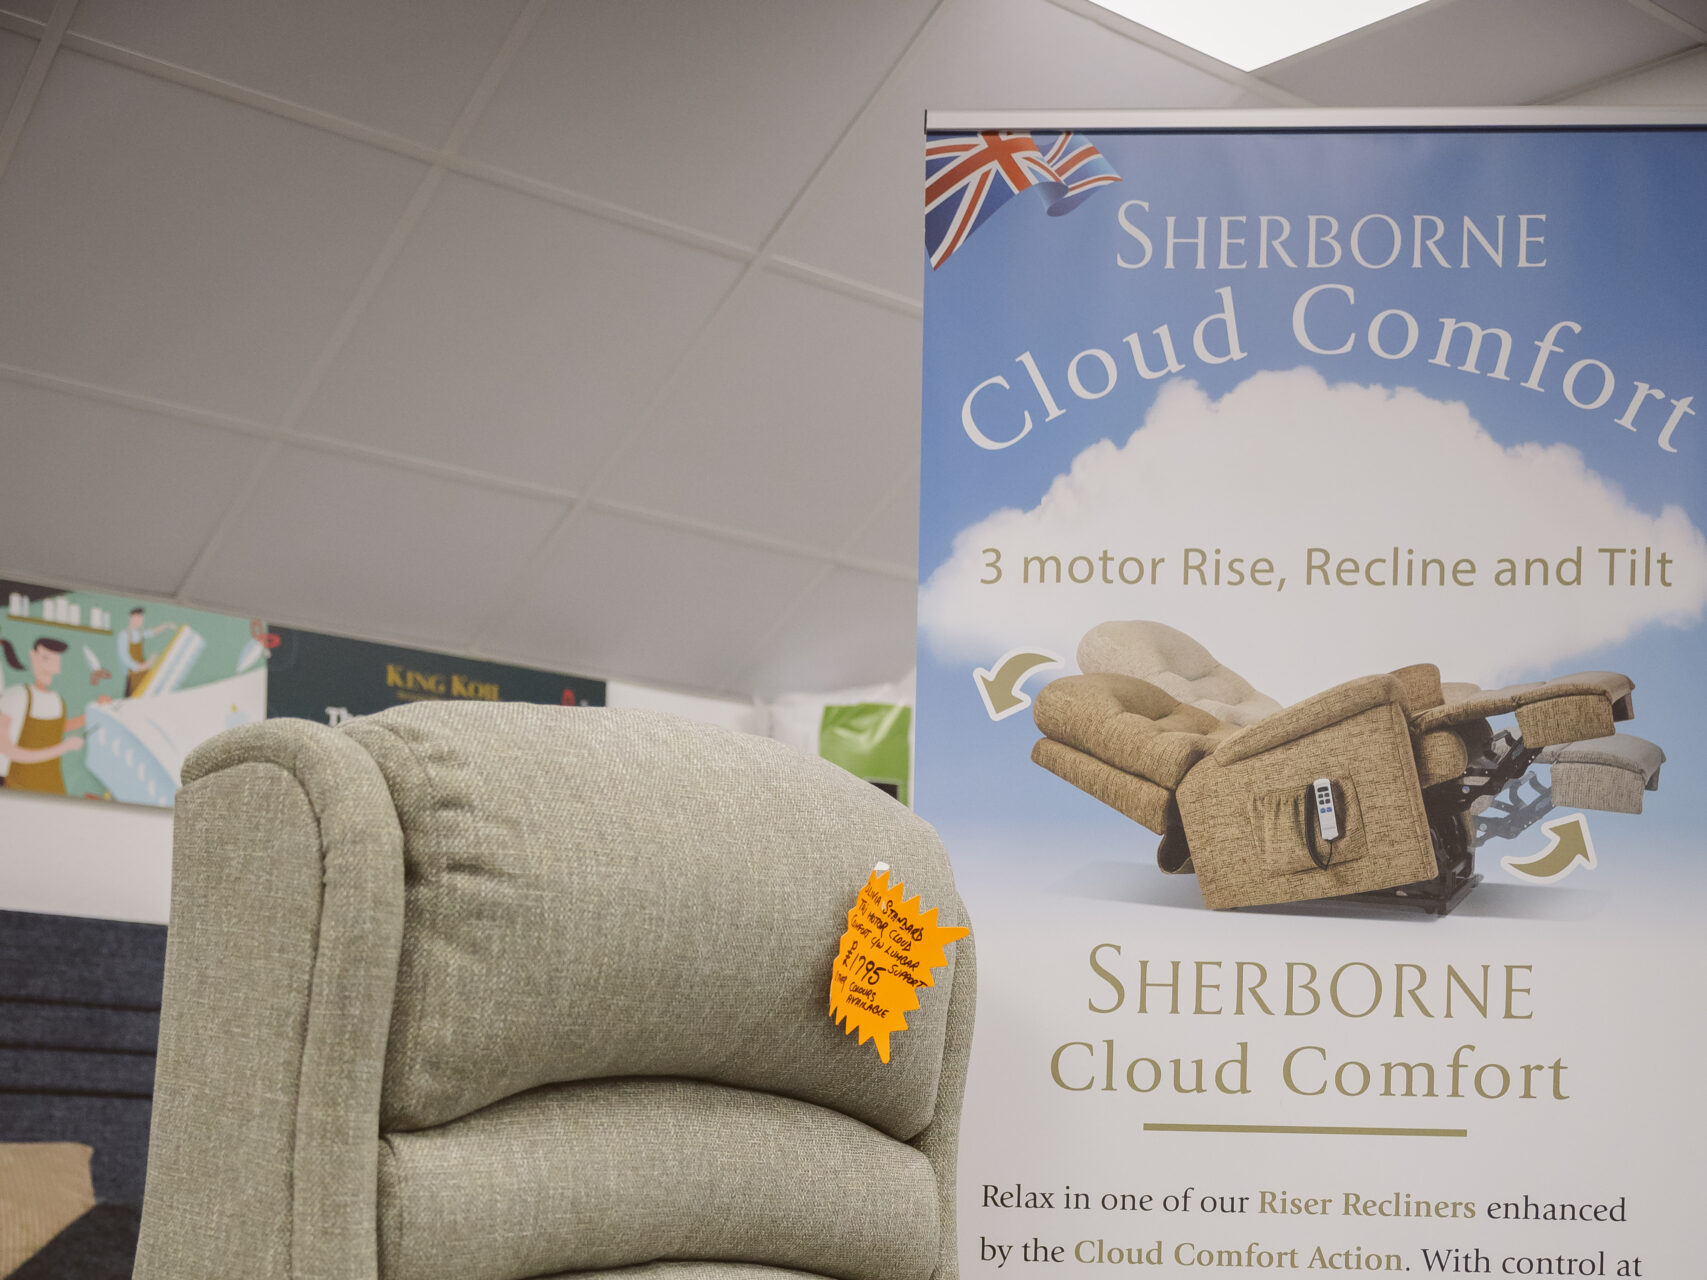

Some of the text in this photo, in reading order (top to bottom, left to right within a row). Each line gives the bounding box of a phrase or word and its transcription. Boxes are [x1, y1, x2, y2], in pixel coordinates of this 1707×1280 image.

[1115, 199, 1549, 270] SHERBORNE
[961, 282, 1698, 454] Cloud Comfort
[981, 546, 1673, 592] 3 motor Rise, Recline and Tilt
[868, 912, 889, 938] MOTOR
[889, 929, 912, 951] CLOUD
[882, 900, 924, 941] STANDARD
[884, 945, 920, 971] LUMBAR
[887, 964, 928, 987] SUPPORT
[849, 981, 877, 1002] COLOURS
[1089, 944, 1533, 1019] SHERBORNE
[846, 994, 889, 1018] AVAILABLE
[1051, 1040, 1570, 1100] Cloud Comfort
[983, 1184, 1626, 1221] Relax in one of our Riser Recliners enhanced
[980, 1237, 1642, 1276] by the Cloud Comfort Action. With control at
